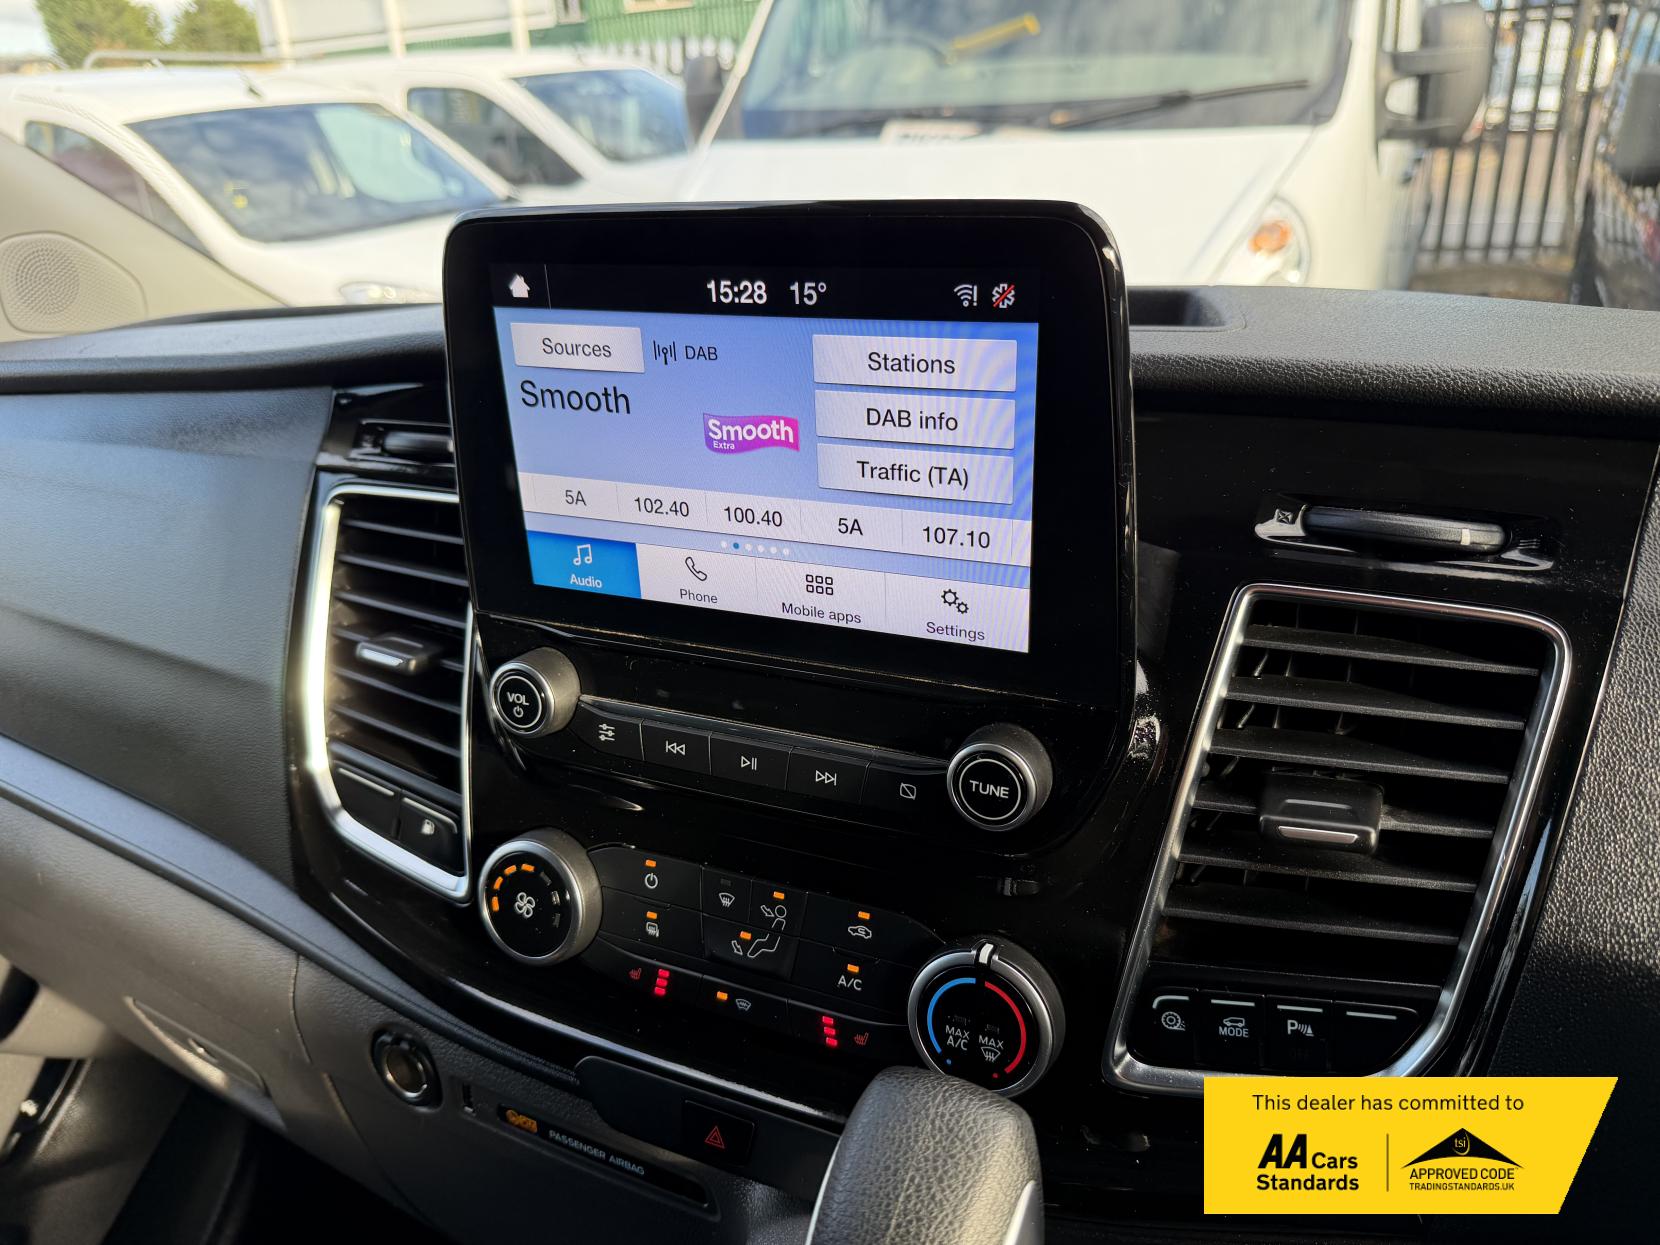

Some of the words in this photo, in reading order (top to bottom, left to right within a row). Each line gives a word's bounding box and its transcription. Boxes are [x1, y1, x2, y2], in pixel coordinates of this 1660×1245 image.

[706, 279, 768, 304] 15:28
[541, 337, 613, 359] Sources
[684, 344, 719, 362] DAB
[867, 351, 956, 376] Stations
[520, 380, 632, 415] Smooth
[865, 408, 911, 430] DAB
[919, 409, 959, 432] info
[707, 417, 795, 444] Smooth
[712, 440, 736, 451] Extra
[857, 460, 922, 485] Traffic
[927, 464, 970, 490] (TA)
[564, 489, 588, 508] 5A
[633, 496, 690, 519] 102.40
[723, 506, 783, 529] 100.40
[837, 517, 864, 537] 5A
[921, 526, 991, 550] 107.10
[570, 573, 603, 590] Audio
[679, 588, 718, 605] Phone
[781, 602, 826, 620] Mobile
[828, 610, 862, 625] apps
[926, 621, 986, 642] Settings
[507, 692, 530, 706] VOL
[969, 780, 1010, 800] TUNE
[837, 975, 863, 991] A/C
[945, 1025, 970, 1040] MAX
[978, 1034, 1004, 1050] MAX
[1218, 1026, 1250, 1039] MODE
[946, 1035, 969, 1051] A/C
[549, 1129, 607, 1160] PASSENGER
[609, 1154, 646, 1176] AIRBAG
